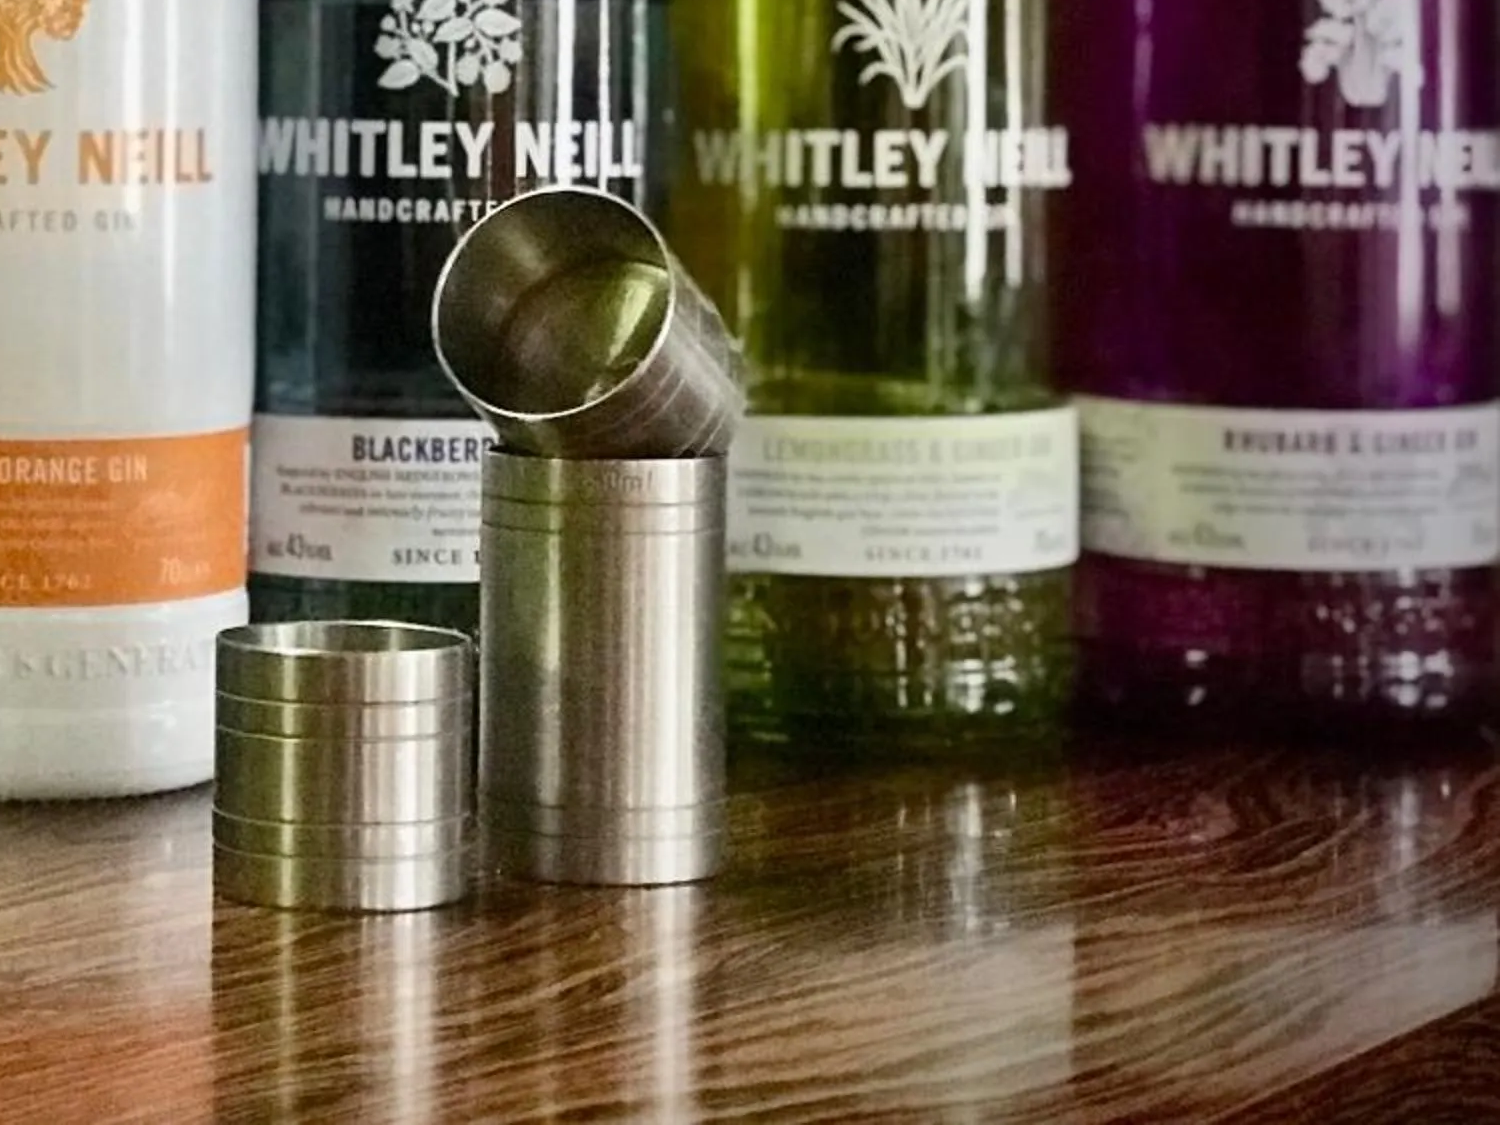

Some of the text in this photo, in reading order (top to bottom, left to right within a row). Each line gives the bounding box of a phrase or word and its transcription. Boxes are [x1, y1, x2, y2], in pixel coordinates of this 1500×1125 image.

[257, 117, 644, 179] WHITLEY NEILL
[694, 127, 948, 188] WHITLEY
[1145, 124, 1401, 189] WHITLEY
[109, 453, 148, 483] GIN
[353, 434, 496, 463] BLACKBER
[392, 548, 463, 566] SINCE
